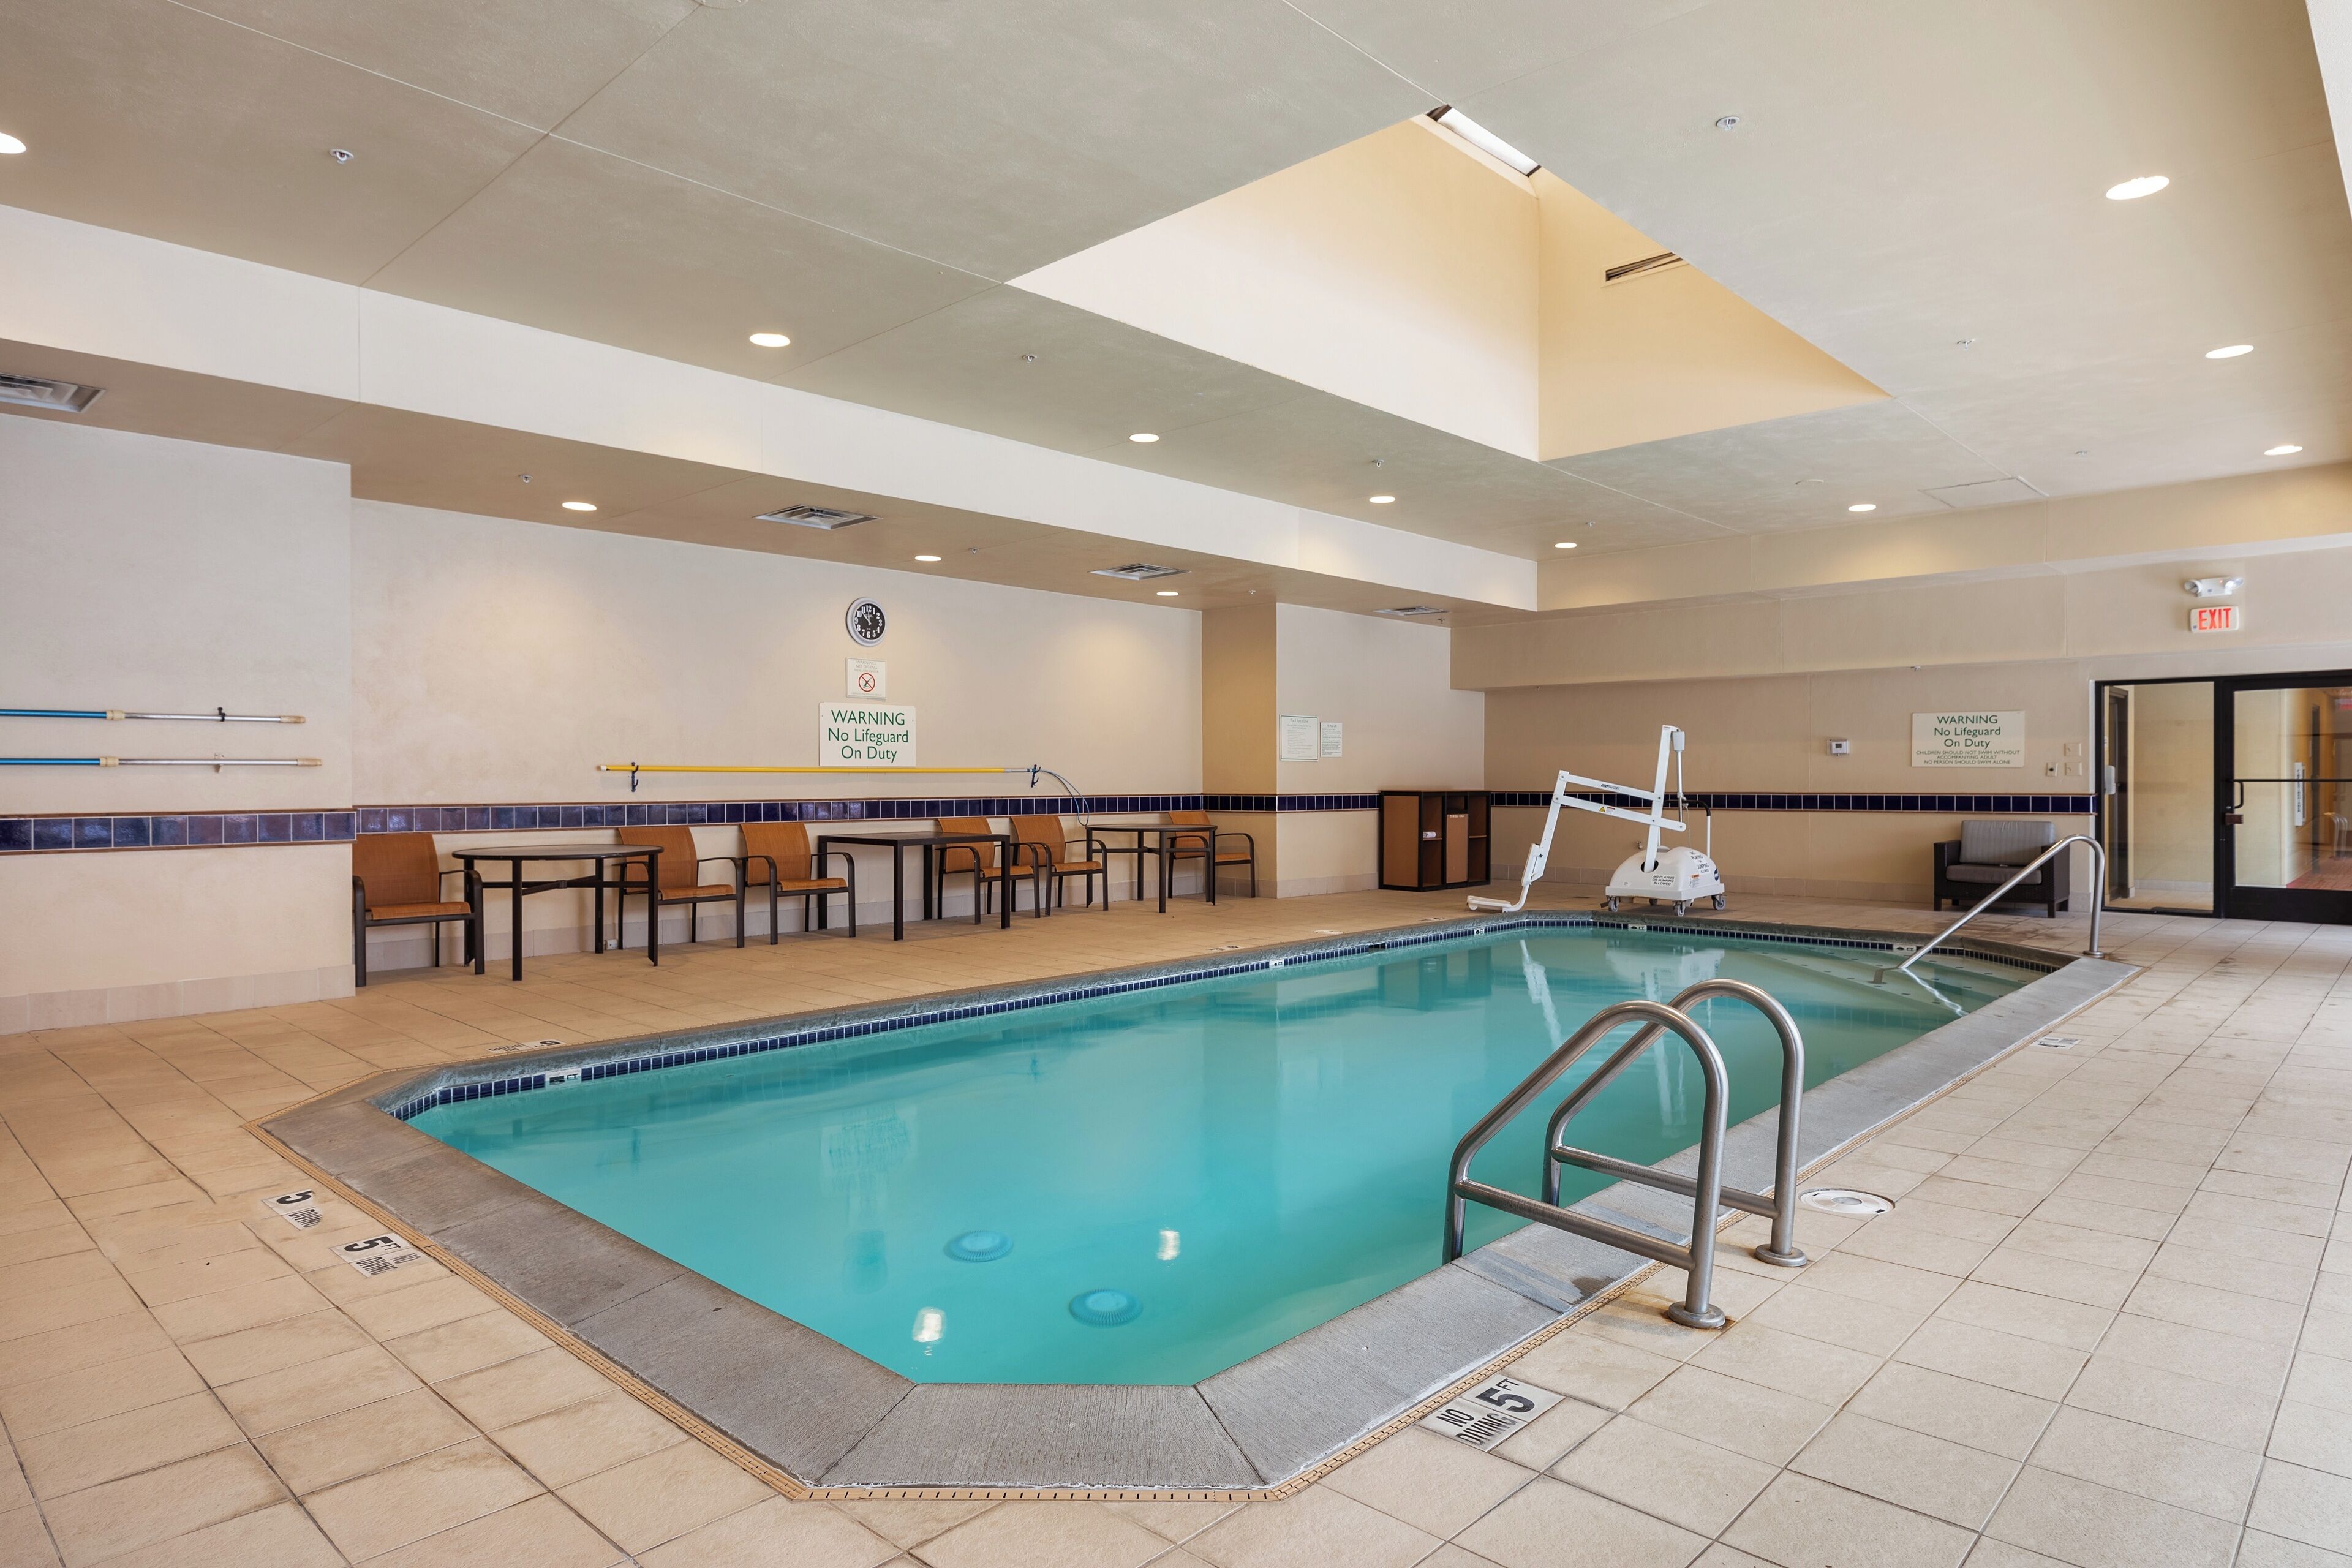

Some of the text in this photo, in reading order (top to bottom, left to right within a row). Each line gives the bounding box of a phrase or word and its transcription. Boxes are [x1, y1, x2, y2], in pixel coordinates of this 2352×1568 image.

[2198, 608, 2231, 630] EXIT
[831, 710, 905, 726] WARNING
[1937, 715, 1998, 724] WARNING
[829, 728, 908, 746] No Lifeguard
[1934, 726, 2001, 738] No Lifeguard
[1944, 738, 1991, 749] On Duty
[842, 745, 897, 764] On Duty
[344, 1236, 394, 1252] 5
[1475, 1378, 1535, 1412] 5 FT
[1436, 1409, 1474, 1427] NO
[1455, 1412, 1518, 1445] DIVING
